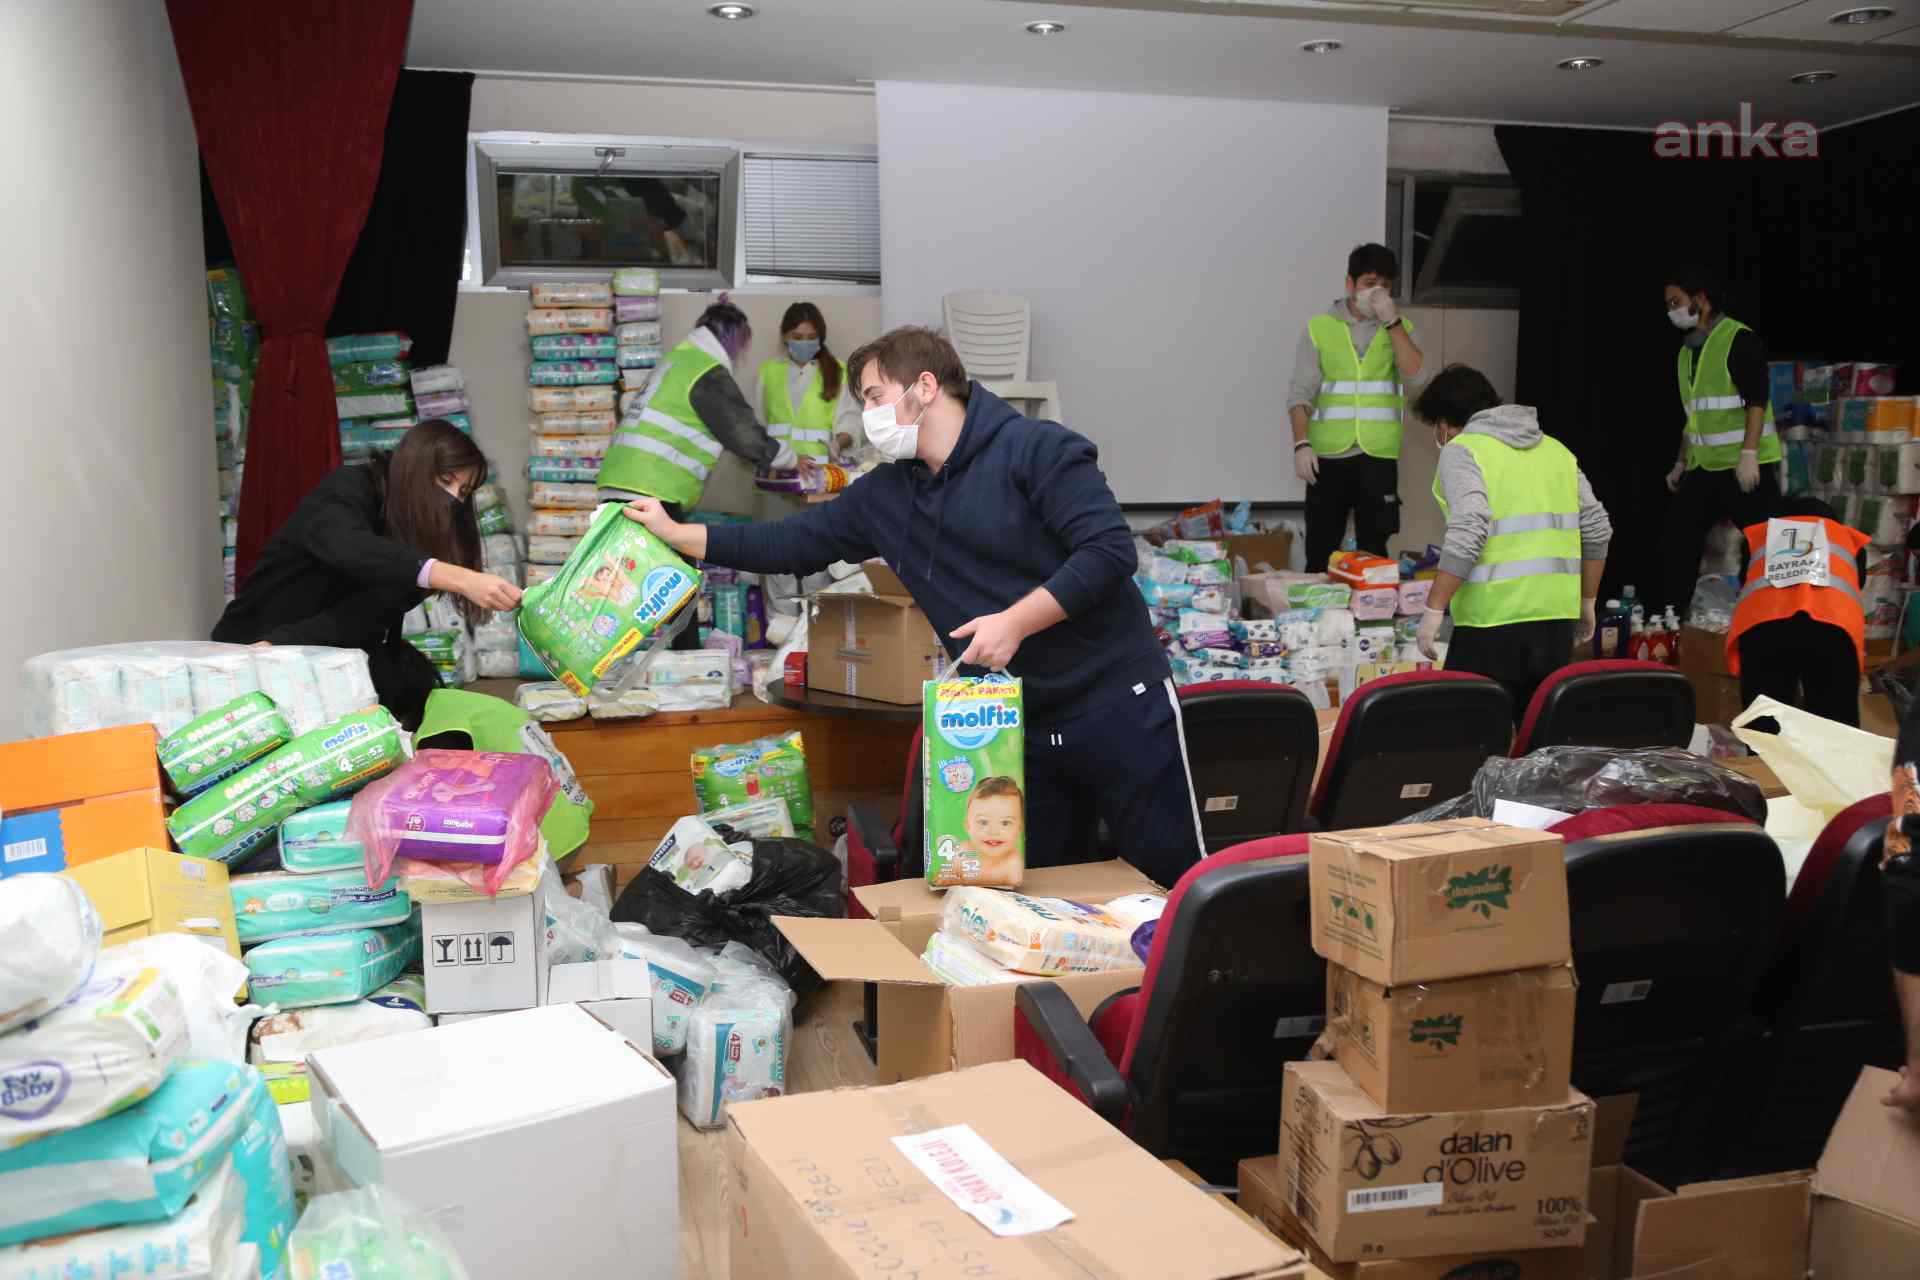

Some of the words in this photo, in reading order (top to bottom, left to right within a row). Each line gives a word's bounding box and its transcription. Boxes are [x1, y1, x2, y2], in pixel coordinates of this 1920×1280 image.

[1768, 559, 1826, 572] BAYRA
[636, 571, 682, 621] molfix
[940, 704, 1018, 729] molfix
[324, 723, 368, 749] molfix
[339, 756, 352, 772] 4
[937, 838, 955, 861] 4
[2, 1079, 54, 1106] Baby
[1440, 1131, 1512, 1155] dalan
[1424, 1157, 1525, 1185] d'Olive
[1537, 1198, 1582, 1214] 100%
